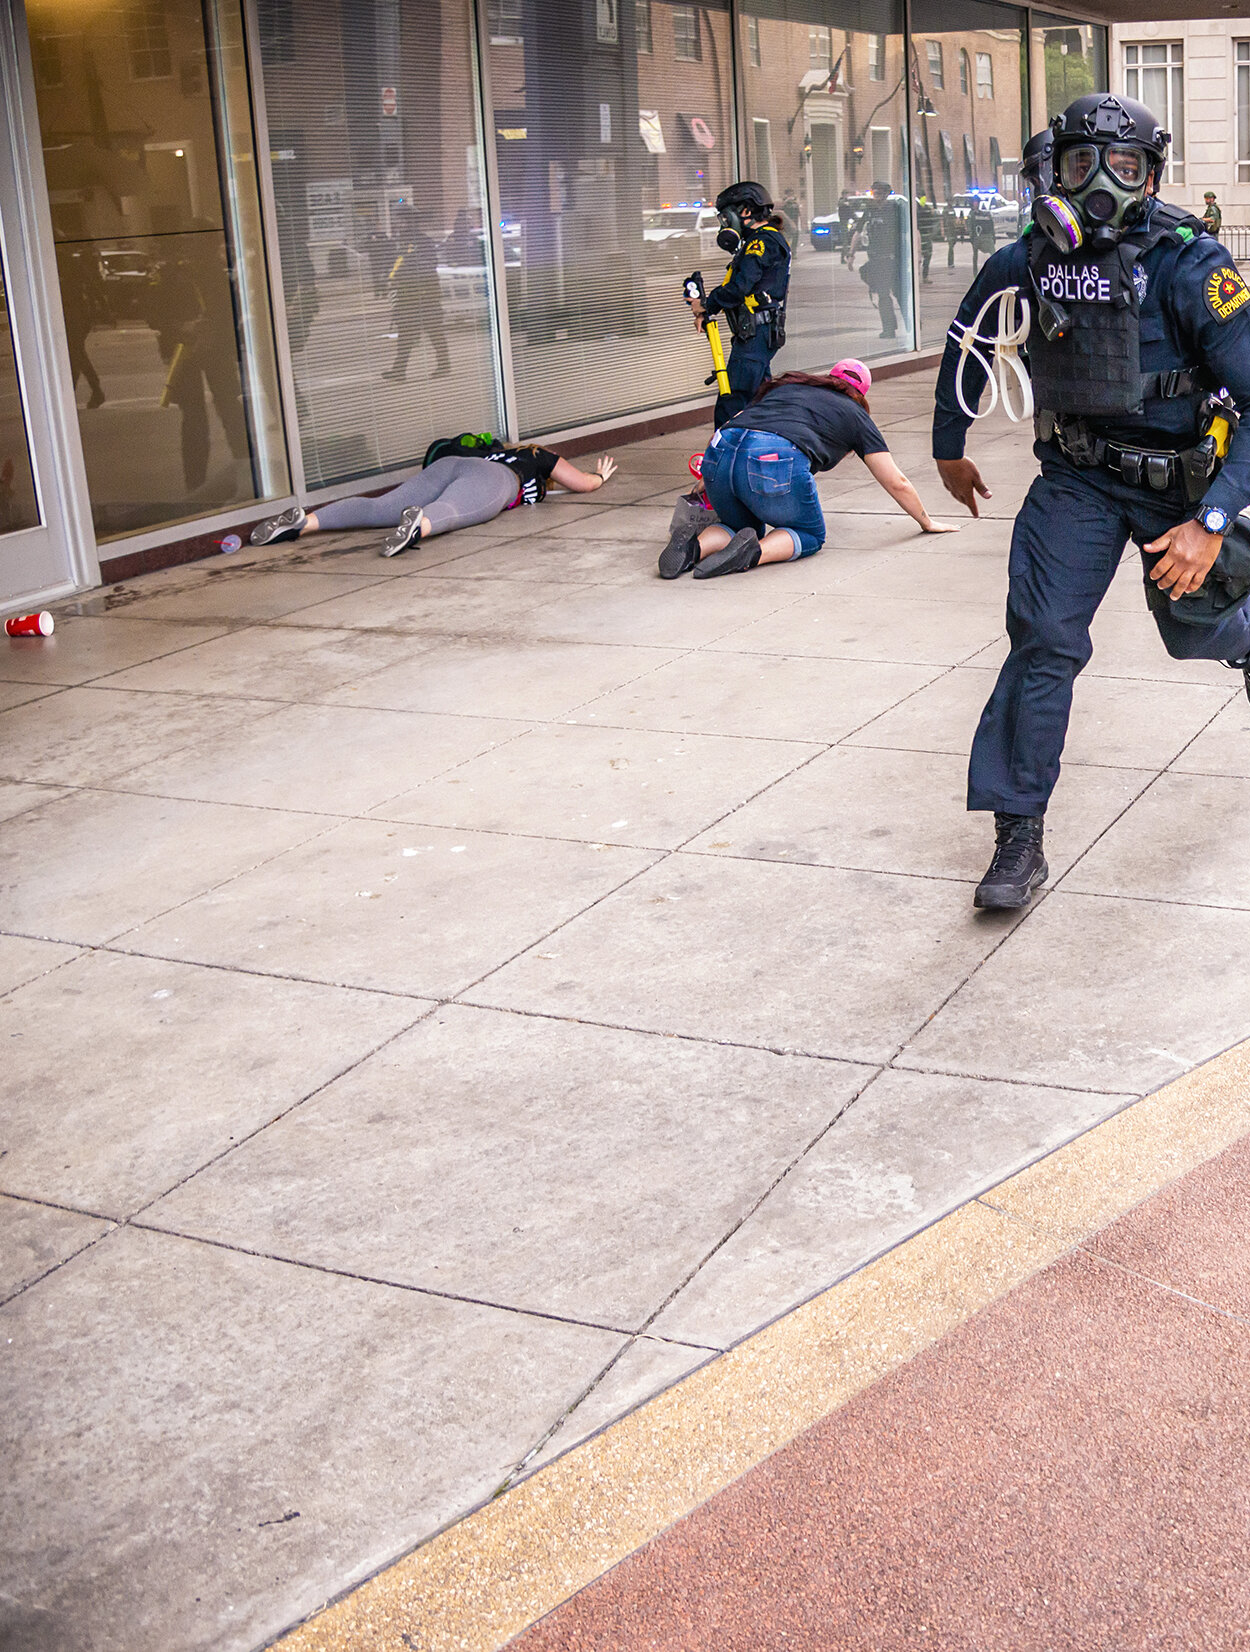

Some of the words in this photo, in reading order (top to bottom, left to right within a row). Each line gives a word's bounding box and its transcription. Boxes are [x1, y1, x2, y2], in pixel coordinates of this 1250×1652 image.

[1048, 264, 1100, 281] DALLAS
[1040, 277, 1111, 301] POLICE
[1207, 272, 1223, 310] DALLAS
